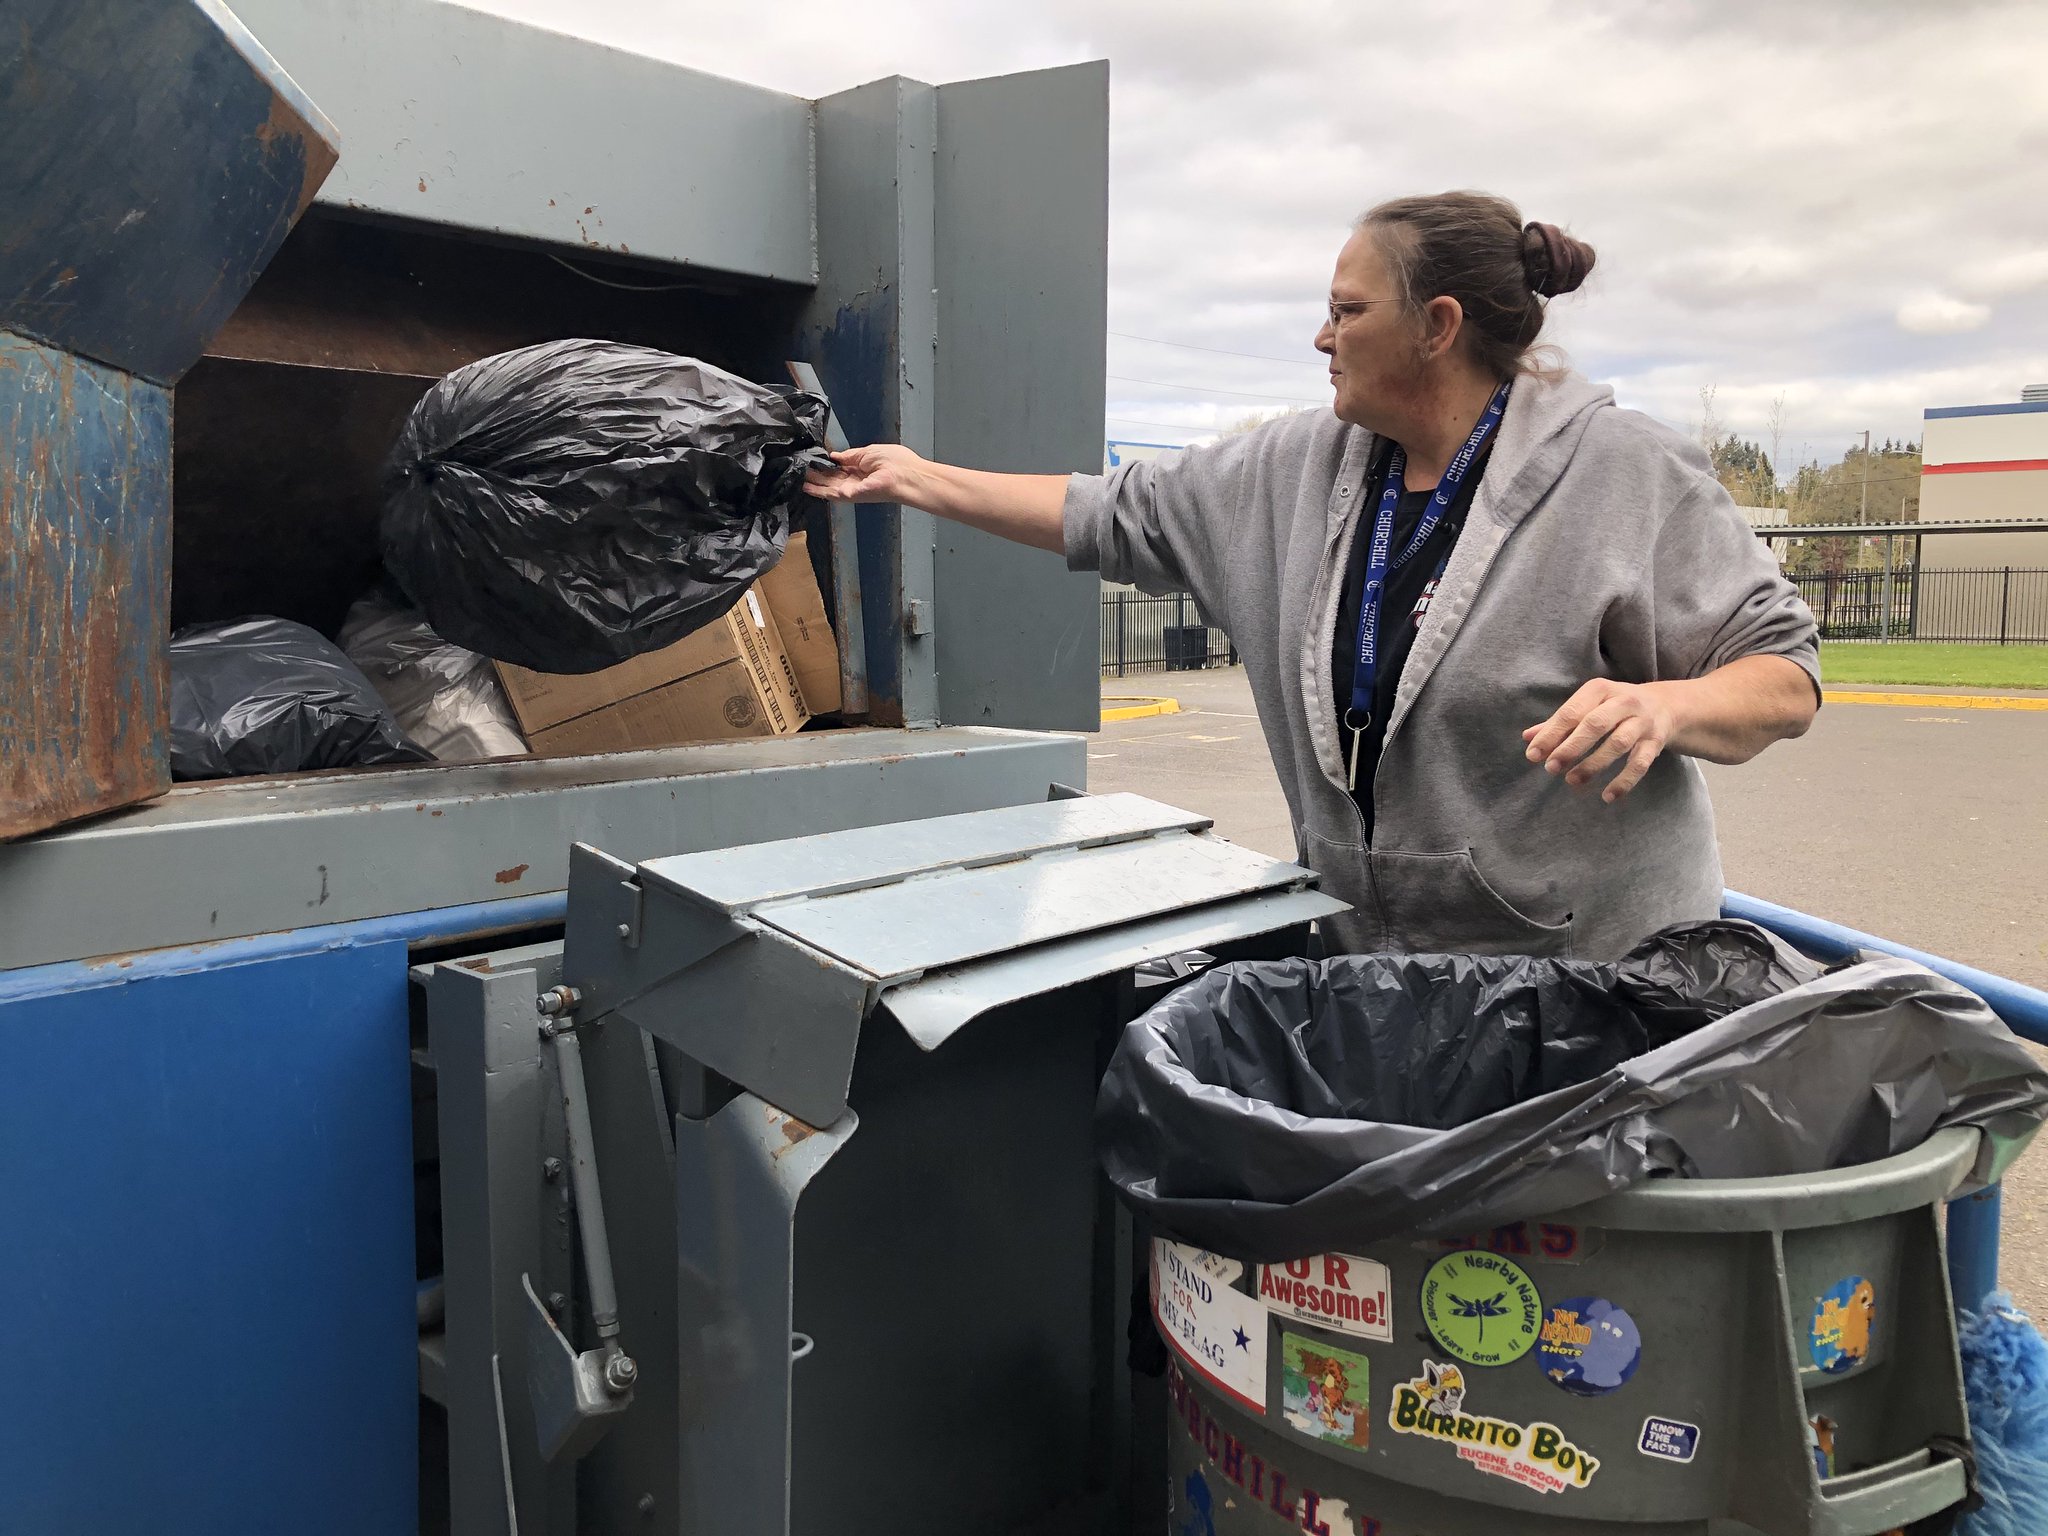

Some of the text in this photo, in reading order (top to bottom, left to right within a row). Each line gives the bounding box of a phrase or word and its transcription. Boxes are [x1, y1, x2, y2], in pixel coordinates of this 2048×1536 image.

[1446, 422, 1490, 483] CHURCHILL
[1370, 510, 1393, 570] CHURCHILL
[1393, 515, 1439, 570] CHURCHILL
[1361, 600, 1377, 665] CHURCHILL
[1162, 1241, 1166, 1262] I
[1169, 1250, 1213, 1305] STAND
[1173, 1281, 1197, 1321] FOR
[1260, 1263, 1386, 1327] Awesome!
[1463, 1254, 1539, 1335] Nearby Nature
[1161, 1293, 1225, 1368] MY FLAG
[1426, 1279, 1501, 1363] Discover Learn Grow
[1541, 1344, 1583, 1357] SHOTS
[1397, 1387, 1597, 1482] BURRITO BOY
[1645, 1439, 1681, 1455] FACTS
[1649, 1430, 1671, 1444] THE
[1650, 1421, 1686, 1438] KNOW
[1460, 1446, 1565, 1491] EUGENE, OREGON
[1477, 1460, 1529, 1483] ESTABLISHED
